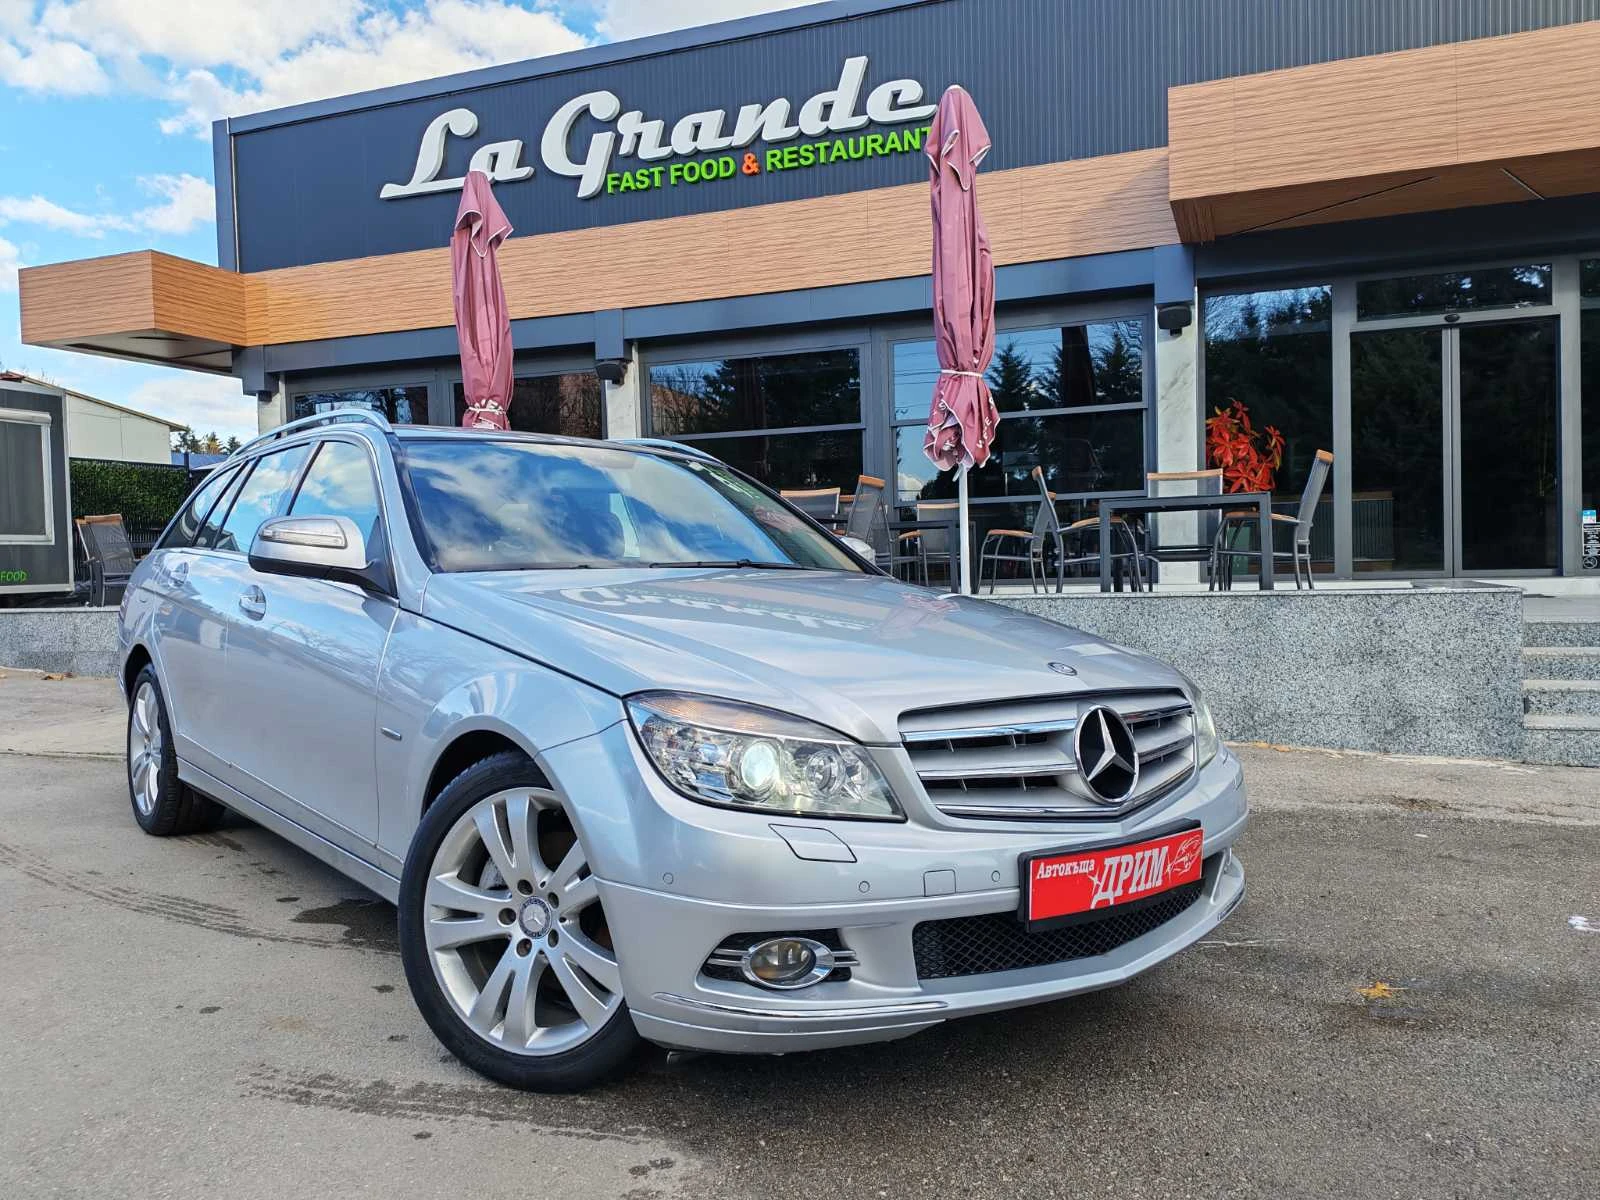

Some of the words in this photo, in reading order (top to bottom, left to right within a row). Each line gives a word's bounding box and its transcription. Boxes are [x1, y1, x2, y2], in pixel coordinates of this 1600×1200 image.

[380, 108, 535, 200] La
[541, 56, 938, 200] Grande
[607, 166, 665, 195] FAST
[670, 157, 736, 186] FOOD
[742, 152, 761, 176] &
[0, 571, 26, 581] FOOD
[1036, 859, 1095, 880] Автокъща
[1090, 846, 1168, 909] ДРИМ
